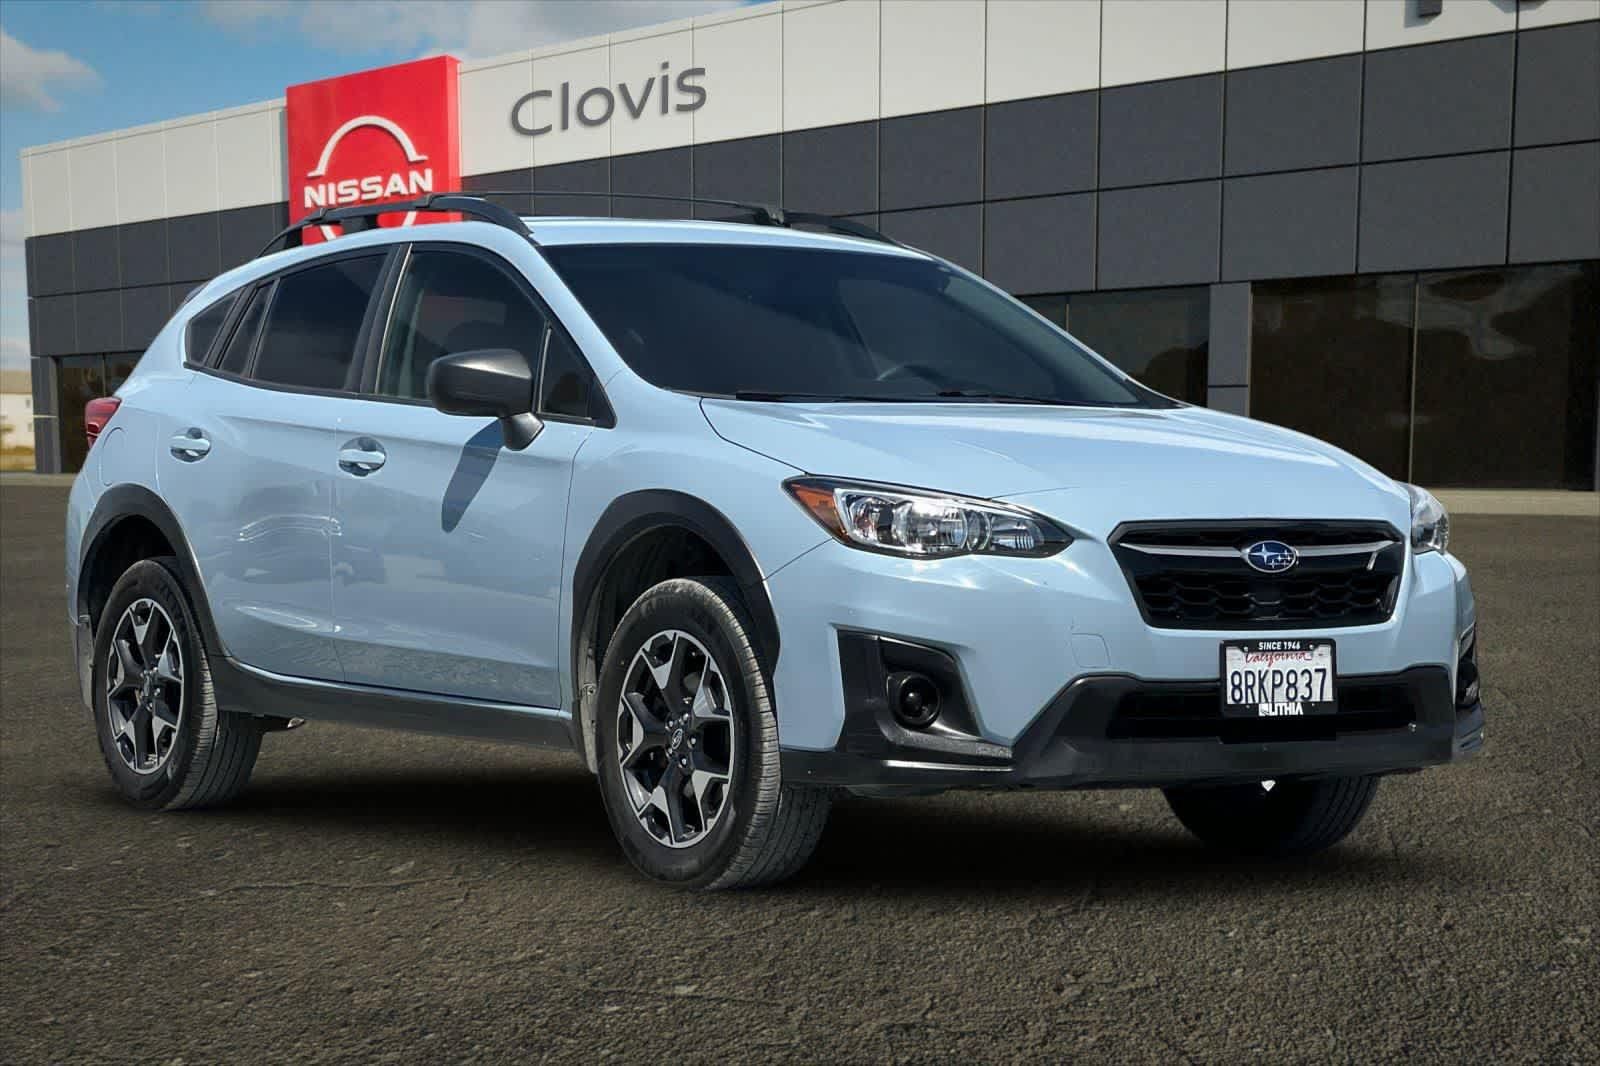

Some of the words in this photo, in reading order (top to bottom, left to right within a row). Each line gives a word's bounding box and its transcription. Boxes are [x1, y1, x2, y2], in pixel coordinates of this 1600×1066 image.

[511, 61, 707, 136] Clovis
[303, 168, 433, 208] NISSAN
[1258, 641, 1282, 650] SINCE
[1283, 641, 1301, 650] 1946
[1230, 668, 1328, 703] 8RKP837
